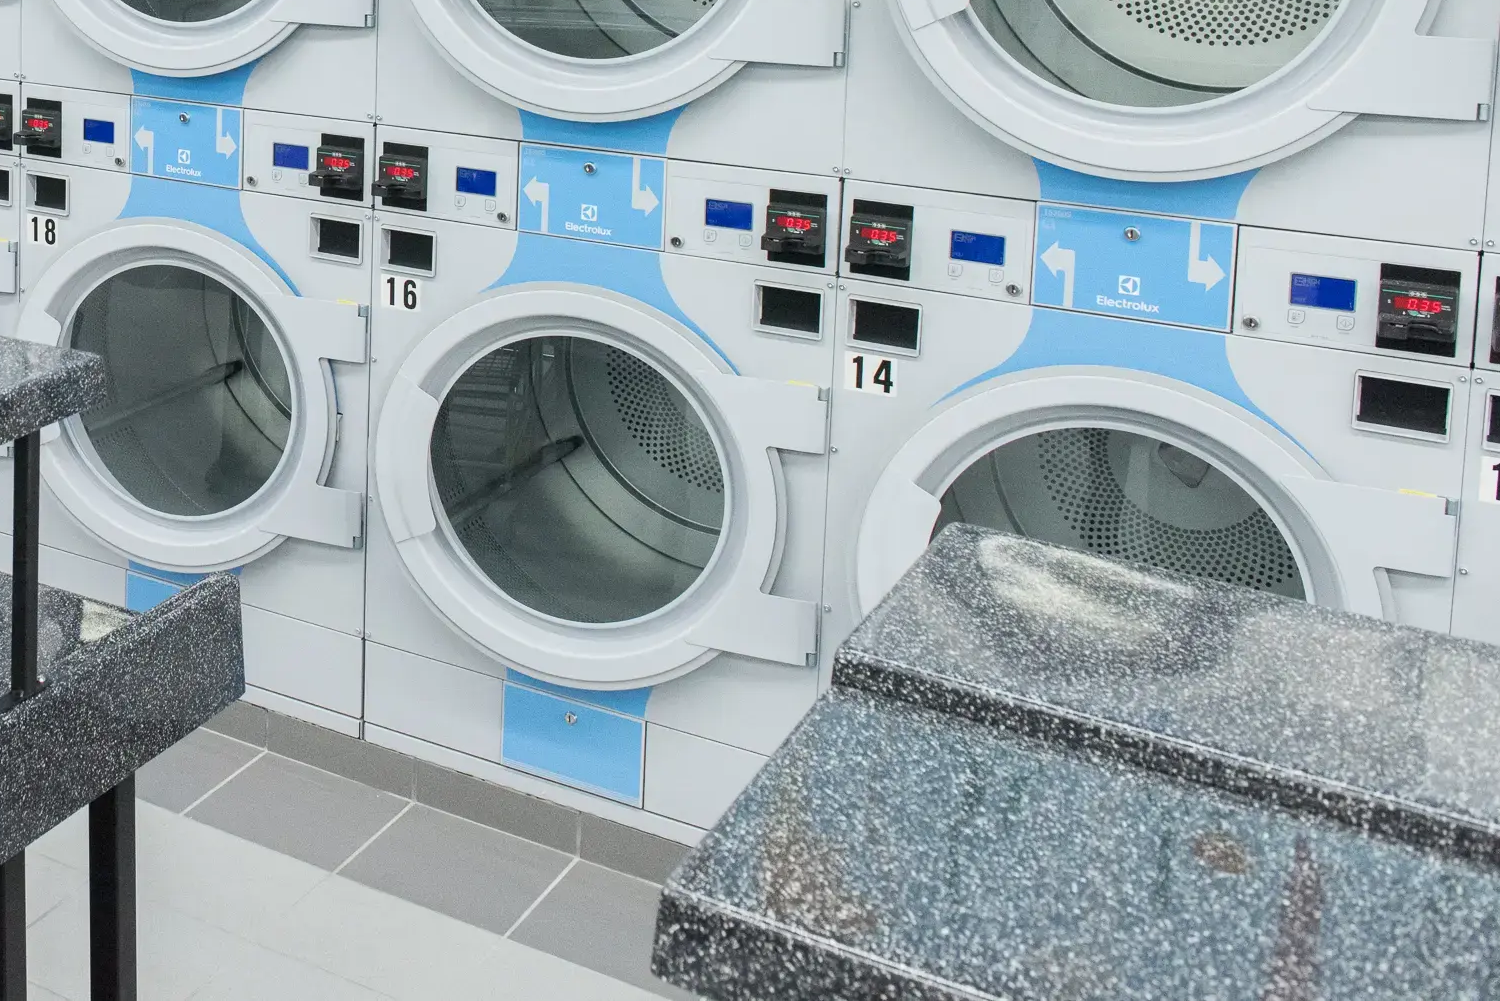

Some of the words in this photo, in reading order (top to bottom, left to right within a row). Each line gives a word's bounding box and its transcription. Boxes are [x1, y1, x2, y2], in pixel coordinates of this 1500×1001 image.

[166, 164, 201, 177] Electrolux
[31, 216, 56, 245] 18
[565, 221, 612, 236] Electrolux
[387, 276, 417, 309] 16
[1096, 295, 1160, 313] Electrolux
[1406, 298, 1442, 314] 0.35
[852, 355, 893, 394] 14
